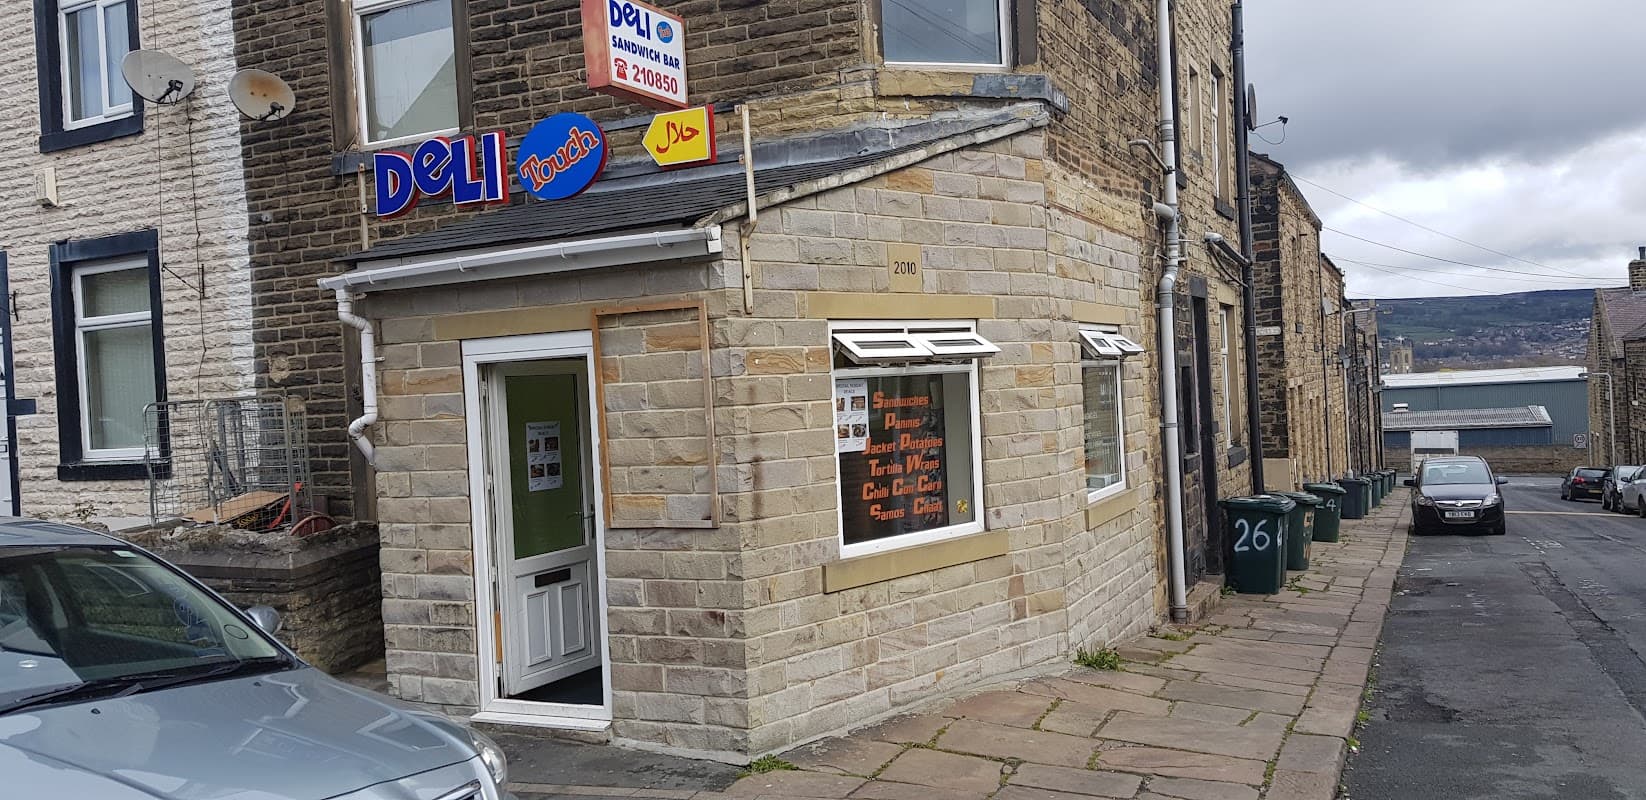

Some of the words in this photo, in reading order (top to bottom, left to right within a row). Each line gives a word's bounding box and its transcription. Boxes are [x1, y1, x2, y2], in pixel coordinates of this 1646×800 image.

[612, 35, 661, 63] SANDWICH
[663, 52, 680, 70] BAR
[632, 64, 679, 95] 210850
[656, 119, 700, 154] حلال
[520, 126, 600, 191] Touch
[894, 260, 917, 275] 2010
[873, 391, 929, 409] Sandwiches
[884, 412, 921, 430] Paninis
[863, 436, 897, 455] Jacket
[900, 432, 943, 451] Potatoes
[868, 458, 903, 477] Tortilla
[906, 452, 940, 473] Wraps
[892, 478, 914, 496] Con
[869, 503, 905, 521] Samos
[1233, 518, 1271, 553] 26
